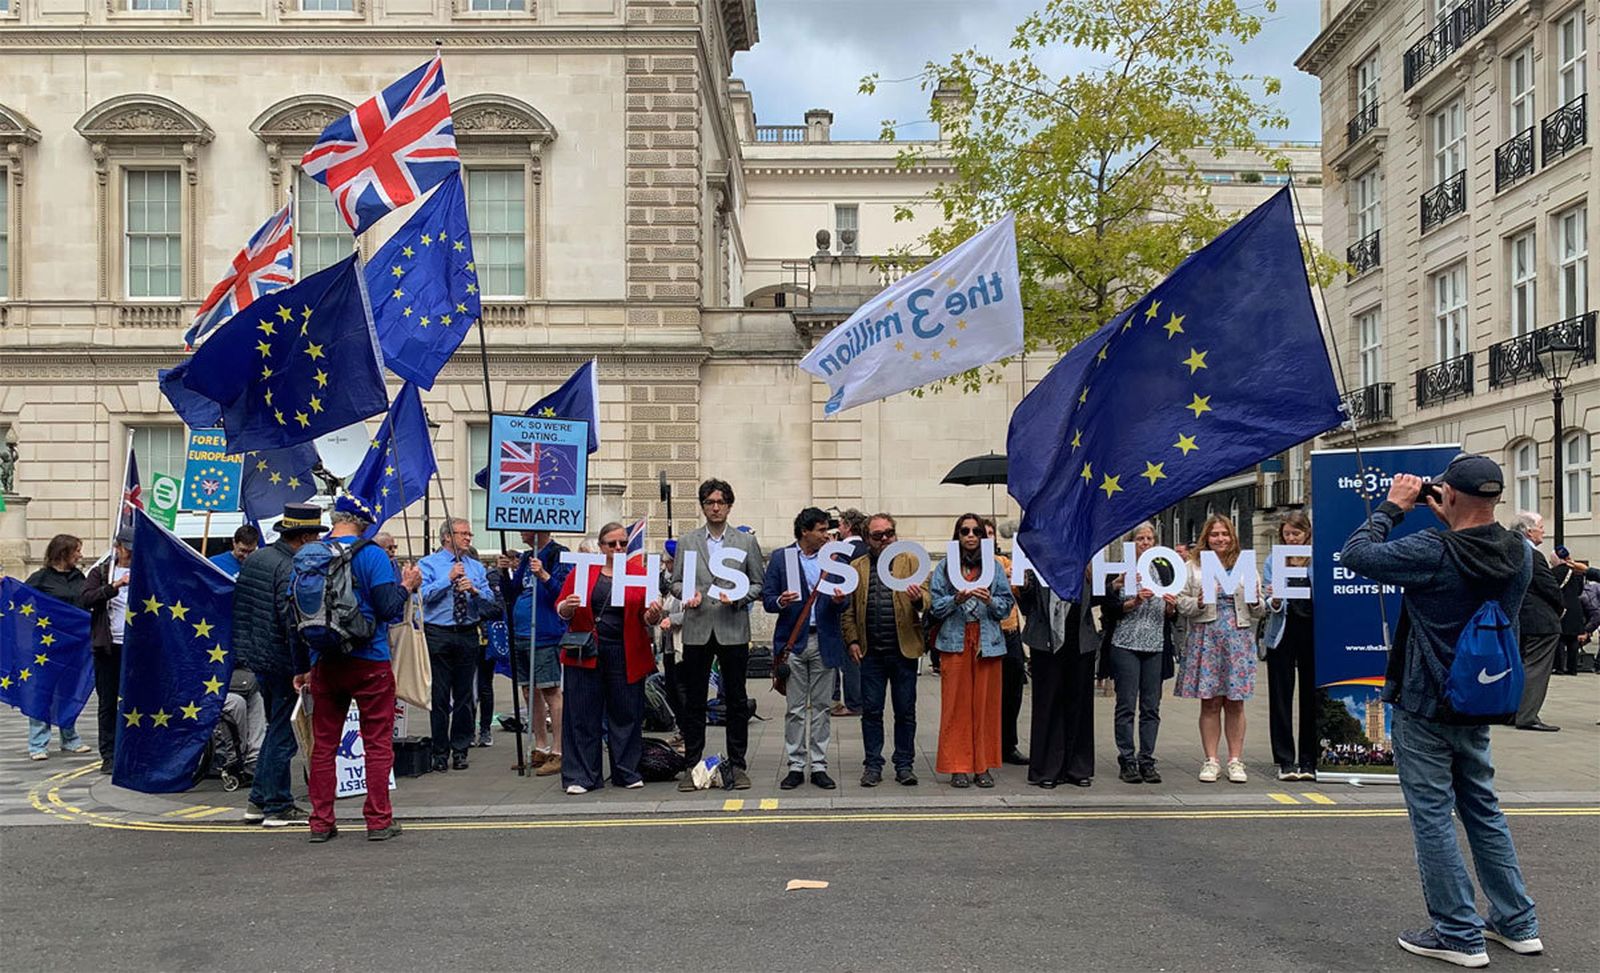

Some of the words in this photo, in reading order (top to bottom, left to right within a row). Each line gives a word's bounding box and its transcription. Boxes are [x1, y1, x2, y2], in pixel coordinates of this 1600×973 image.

[528, 421, 542, 430] SO
[543, 423, 572, 432] WE'RE
[188, 450, 242, 464] EUROPEAN
[1338, 476, 1363, 489] the
[1364, 473, 1377, 492] 3
[511, 496, 535, 505] NOW
[538, 497, 566, 507] LET'S
[495, 507, 582, 526] REMARRY
[560, 547, 750, 607] THIS
[784, 540, 859, 602] IS
[1092, 541, 1313, 605] HOME
[1333, 585, 1379, 595] RIGHTS
[1382, 584, 1396, 594] IN
